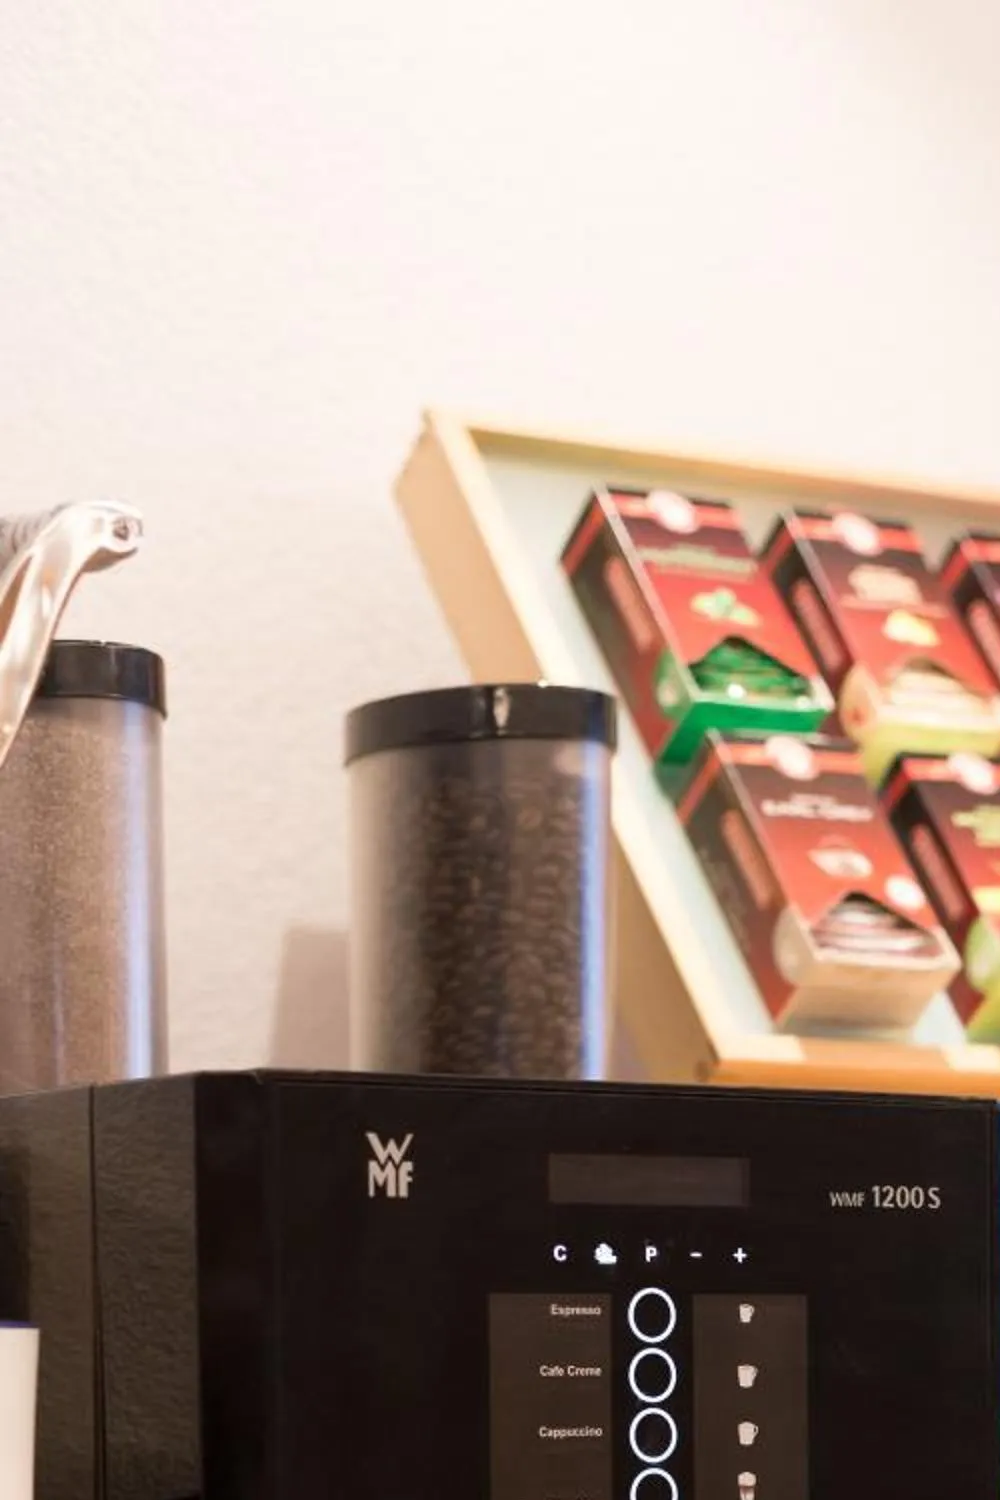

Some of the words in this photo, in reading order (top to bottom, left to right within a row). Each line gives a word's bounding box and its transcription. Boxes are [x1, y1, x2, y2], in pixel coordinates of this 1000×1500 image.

[365, 1131, 414, 1199] WMF
[828, 1191, 865, 1208] WMF
[553, 1244, 568, 1263] C
[645, 1245, 658, 1263] P
[550, 1303, 602, 1317] Espresso
[538, 1425, 604, 1439] Cappuccino
